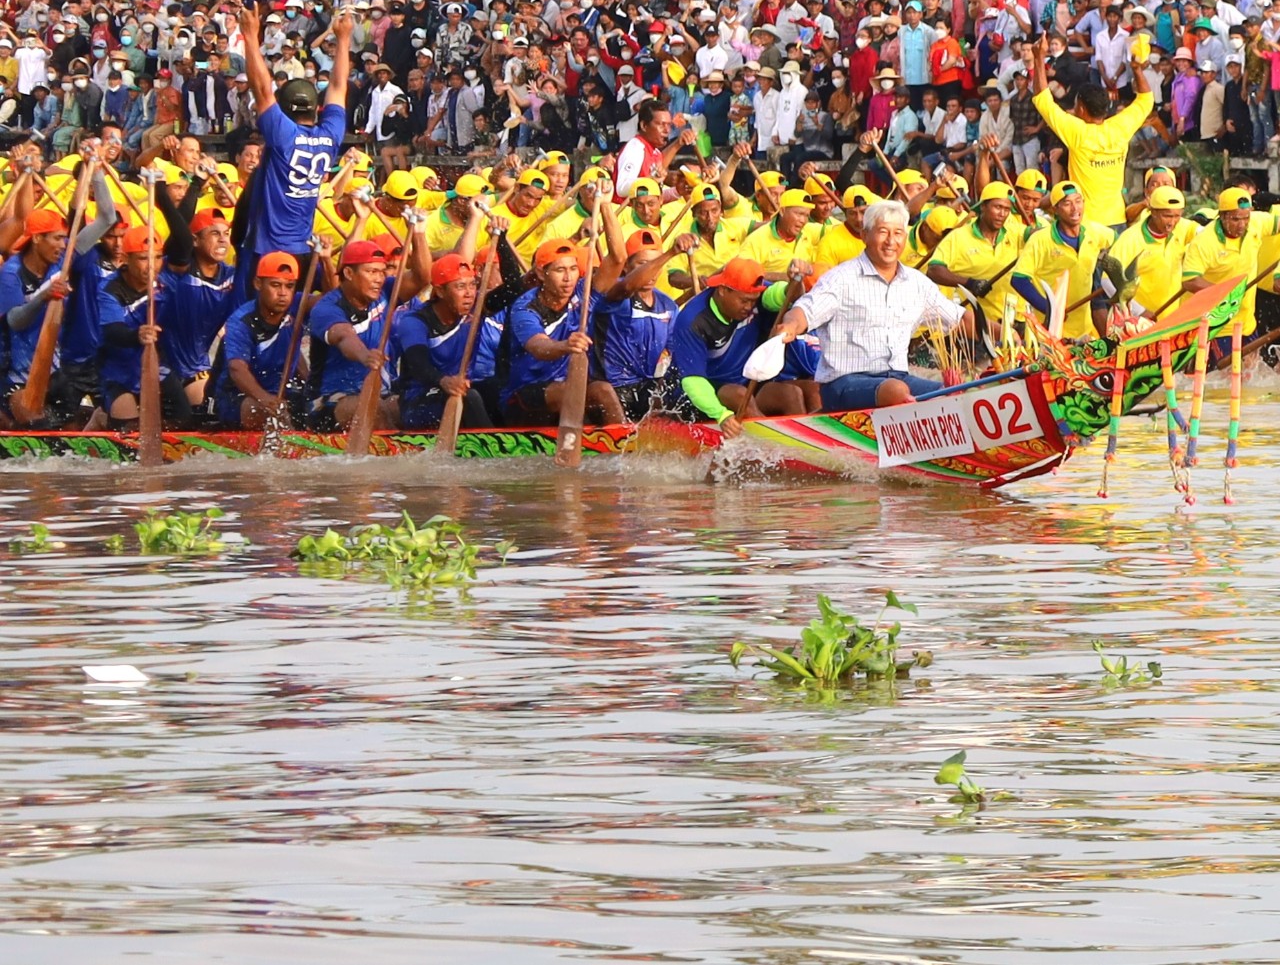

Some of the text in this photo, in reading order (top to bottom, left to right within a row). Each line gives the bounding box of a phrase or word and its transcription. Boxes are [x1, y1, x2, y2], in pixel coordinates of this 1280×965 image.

[880, 406, 967, 458] CHÙA WÁTH PÍCH
[973, 393, 1033, 440] 02
